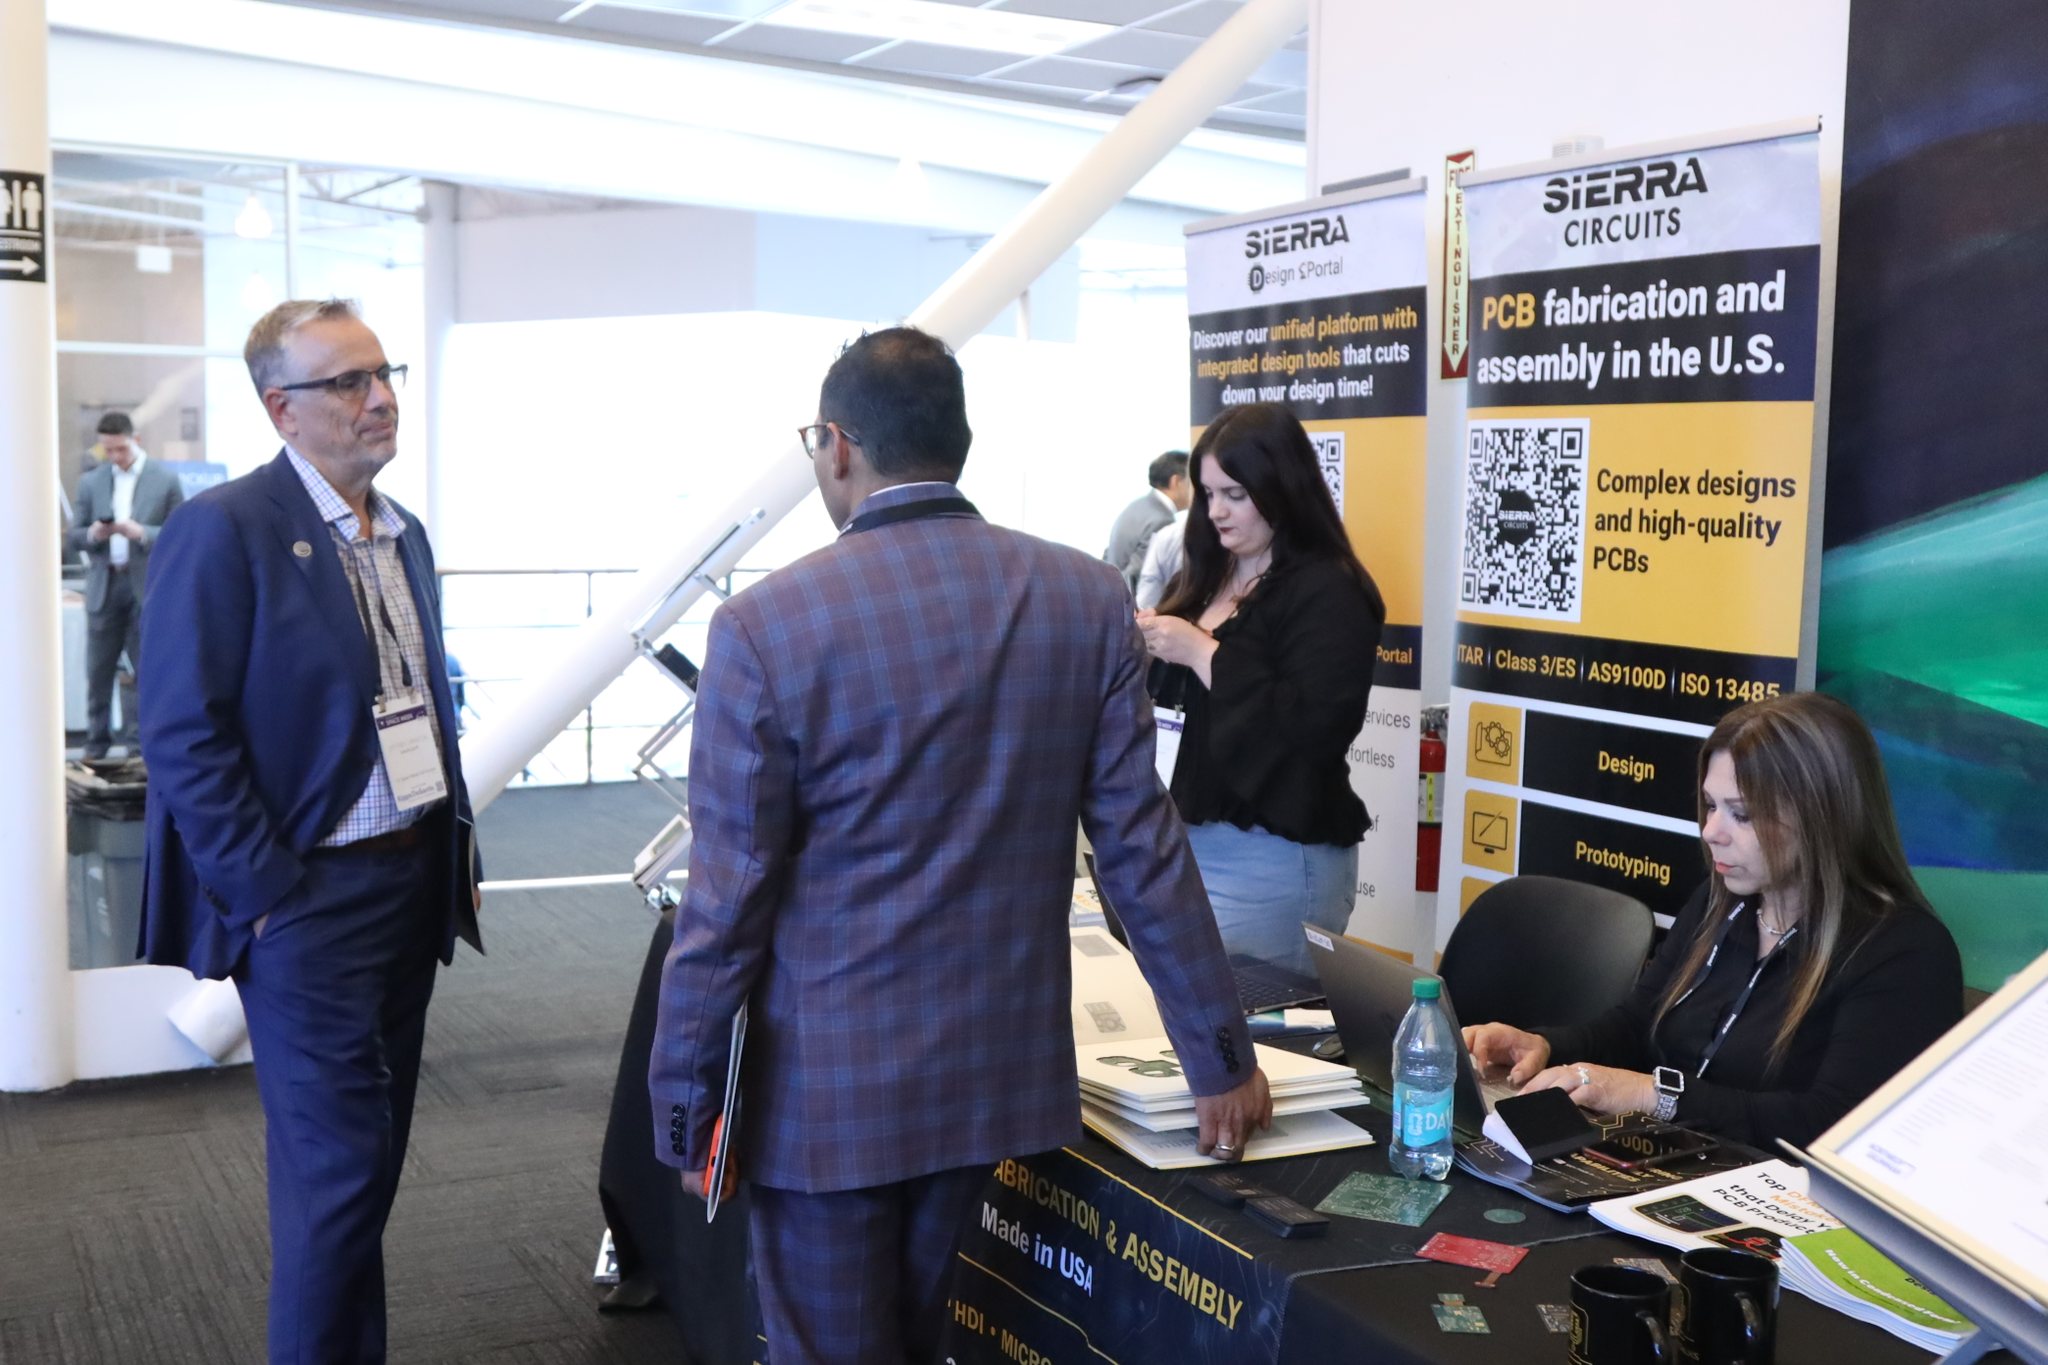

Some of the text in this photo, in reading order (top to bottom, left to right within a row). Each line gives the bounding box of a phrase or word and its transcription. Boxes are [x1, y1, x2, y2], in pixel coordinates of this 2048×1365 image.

[1563, 206, 1682, 247] CIRCUITS
[1452, 192, 1463, 355] EXTINGUISHER
[1482, 269, 1786, 331] PCB fabrication and
[1193, 305, 1418, 350] Discover our unified platform with
[1197, 341, 1411, 380] integrated design tools that cuts
[1477, 333, 1785, 390] assembly in the U.S.
[1222, 374, 1374, 405] down your design time!
[1596, 468, 1796, 504] Complex designs
[1503, 521, 1529, 530] CIRCUITS
[1594, 507, 1782, 547] and high-quality
[1593, 546, 1649, 573] PCBs
[1376, 644, 1412, 665] Portal
[1457, 643, 1780, 703] ITAR Class 3/ES AS9100D ISO 13485
[1365, 709, 1411, 729] ervices
[1598, 751, 1655, 782] Design
[1575, 841, 1671, 886] Prototyping
[1713, 1188, 1749, 1208] PCB
[1757, 1172, 1787, 1191] Top
[1730, 1184, 1766, 1205] that
[1764, 1204, 1816, 1224] Delay
[981, 1201, 1093, 1298] Made in USA
[1105, 1219, 1118, 1255] &
[1122, 1232, 1243, 1331] ASSEMBLY
[954, 1299, 984, 1335] HDI
